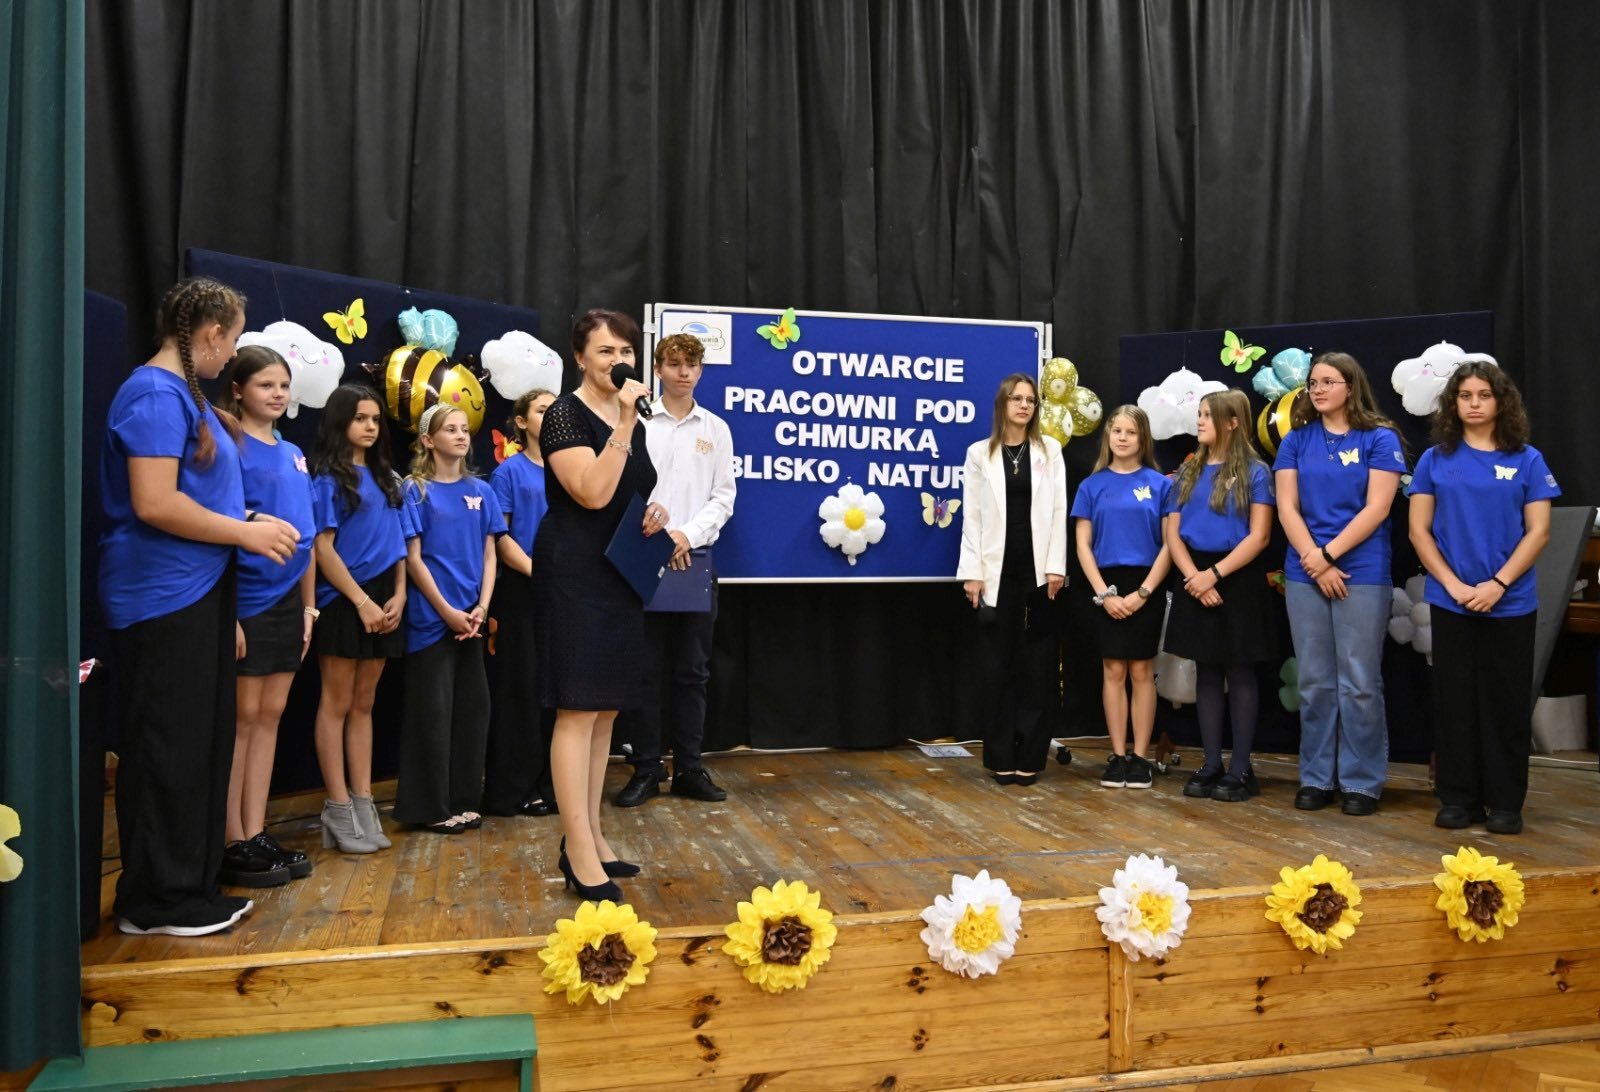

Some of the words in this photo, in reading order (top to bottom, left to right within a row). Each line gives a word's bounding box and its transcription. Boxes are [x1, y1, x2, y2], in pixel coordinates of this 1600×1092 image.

[792, 350, 965, 383] OTWARCIE
[724, 386, 897, 421] PRACOWNI
[915, 399, 976, 424] POD
[775, 420, 940, 459] CHMURKĄ
[729, 454, 840, 484] BLISKO
[868, 462, 965, 489] NATUR
